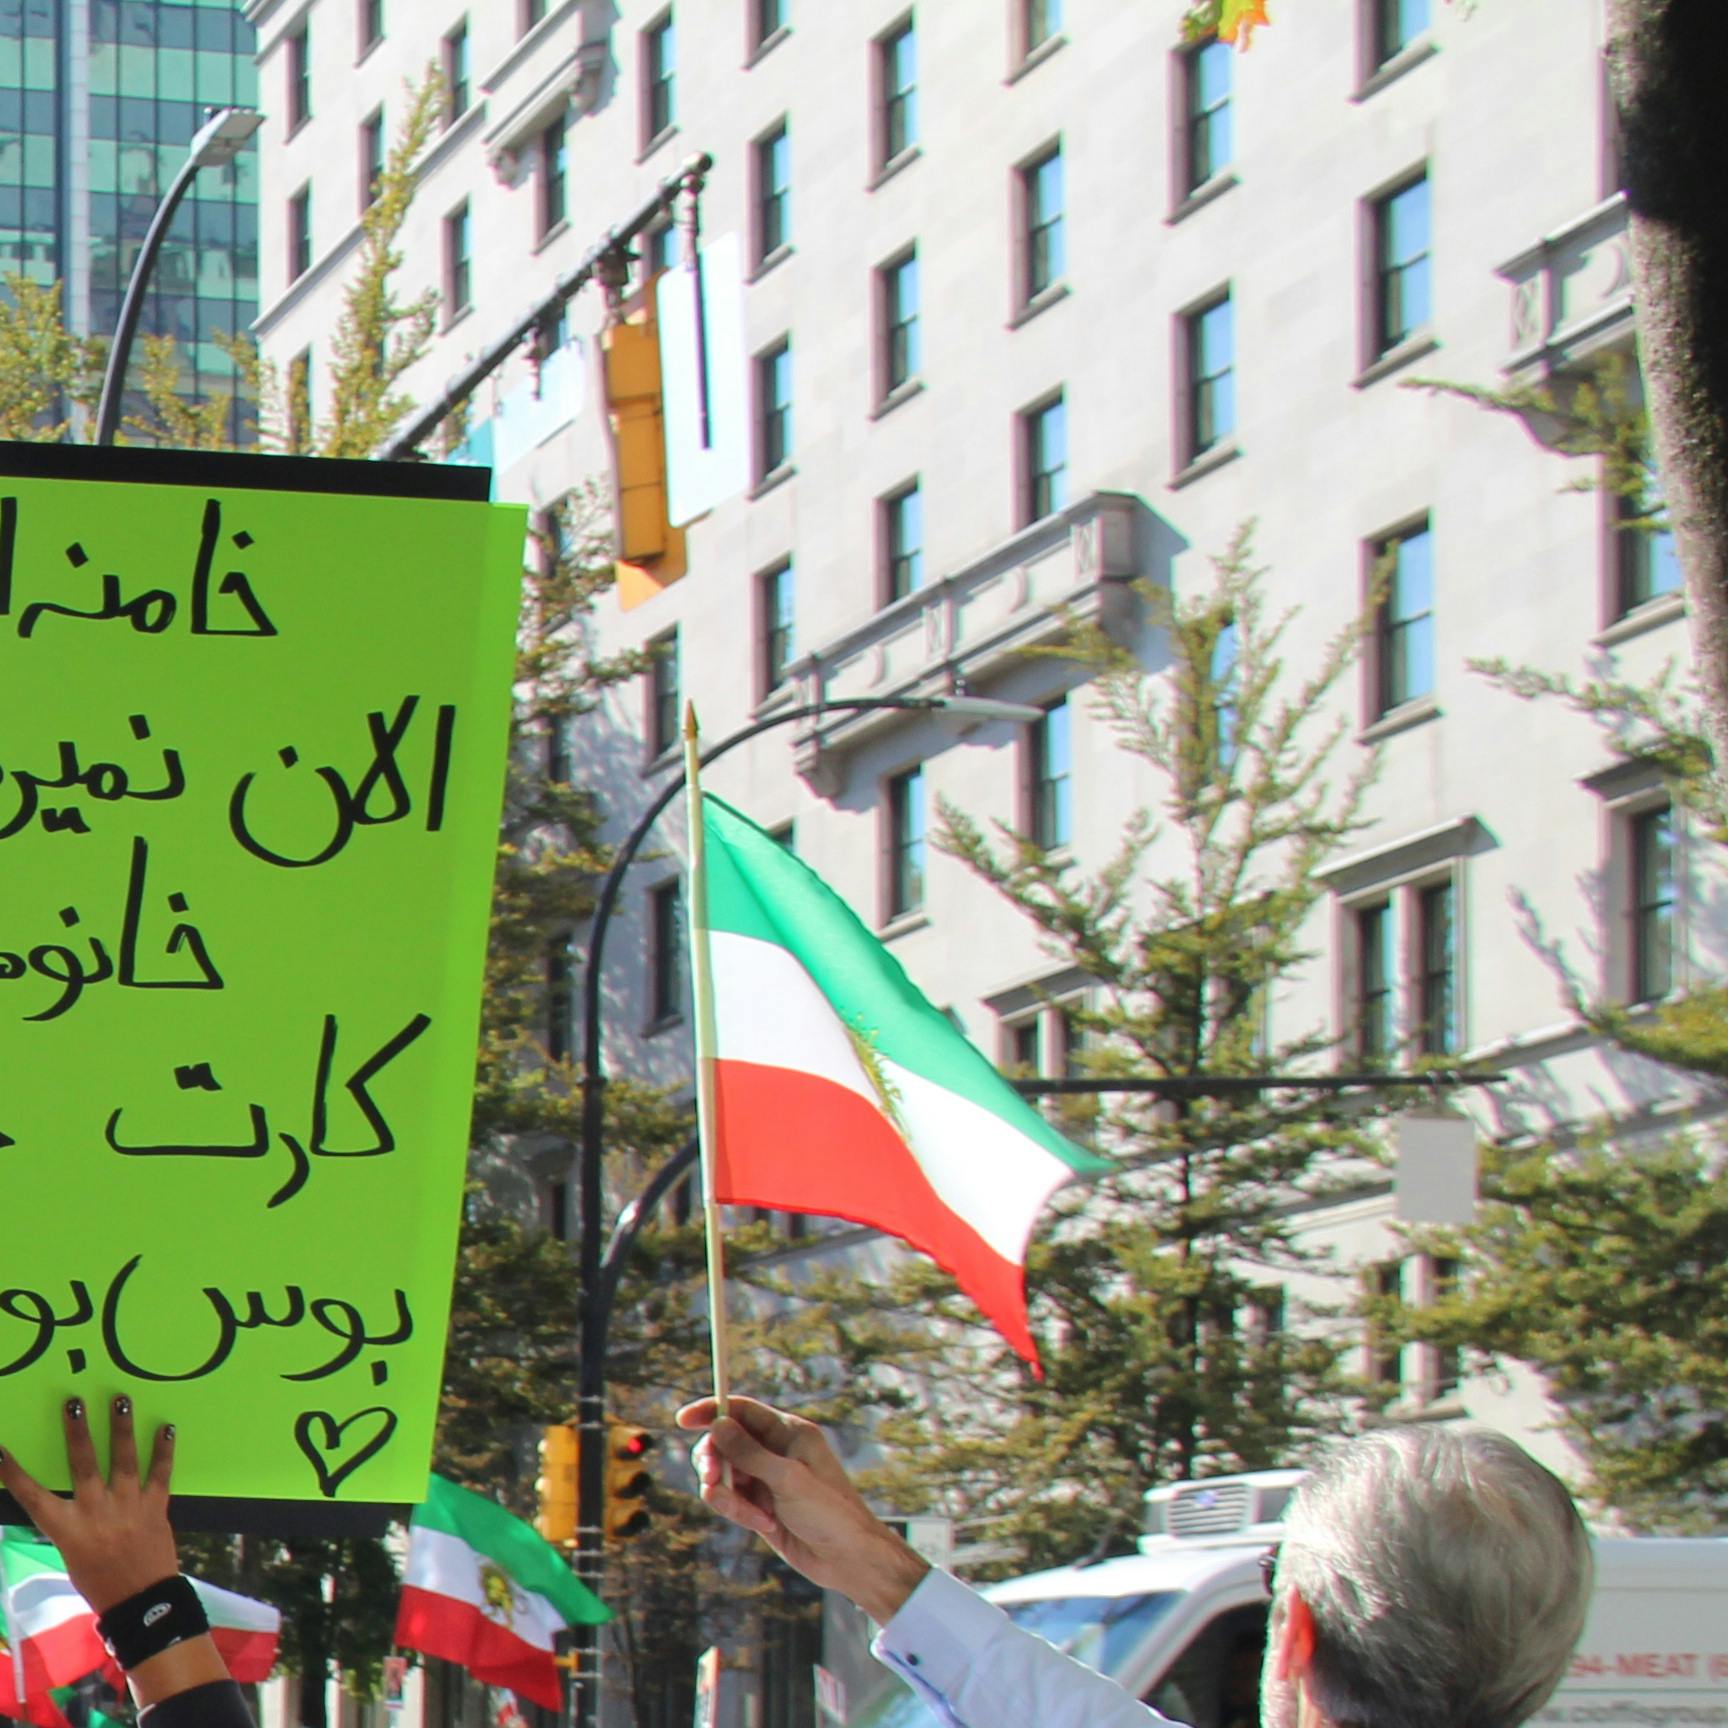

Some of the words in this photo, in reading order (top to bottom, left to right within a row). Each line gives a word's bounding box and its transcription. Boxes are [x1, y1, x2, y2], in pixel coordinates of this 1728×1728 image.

[229, 695, 456, 868] الان
[104, 1013, 432, 1208] کارت
[102, 1253, 414, 1388] بوس
